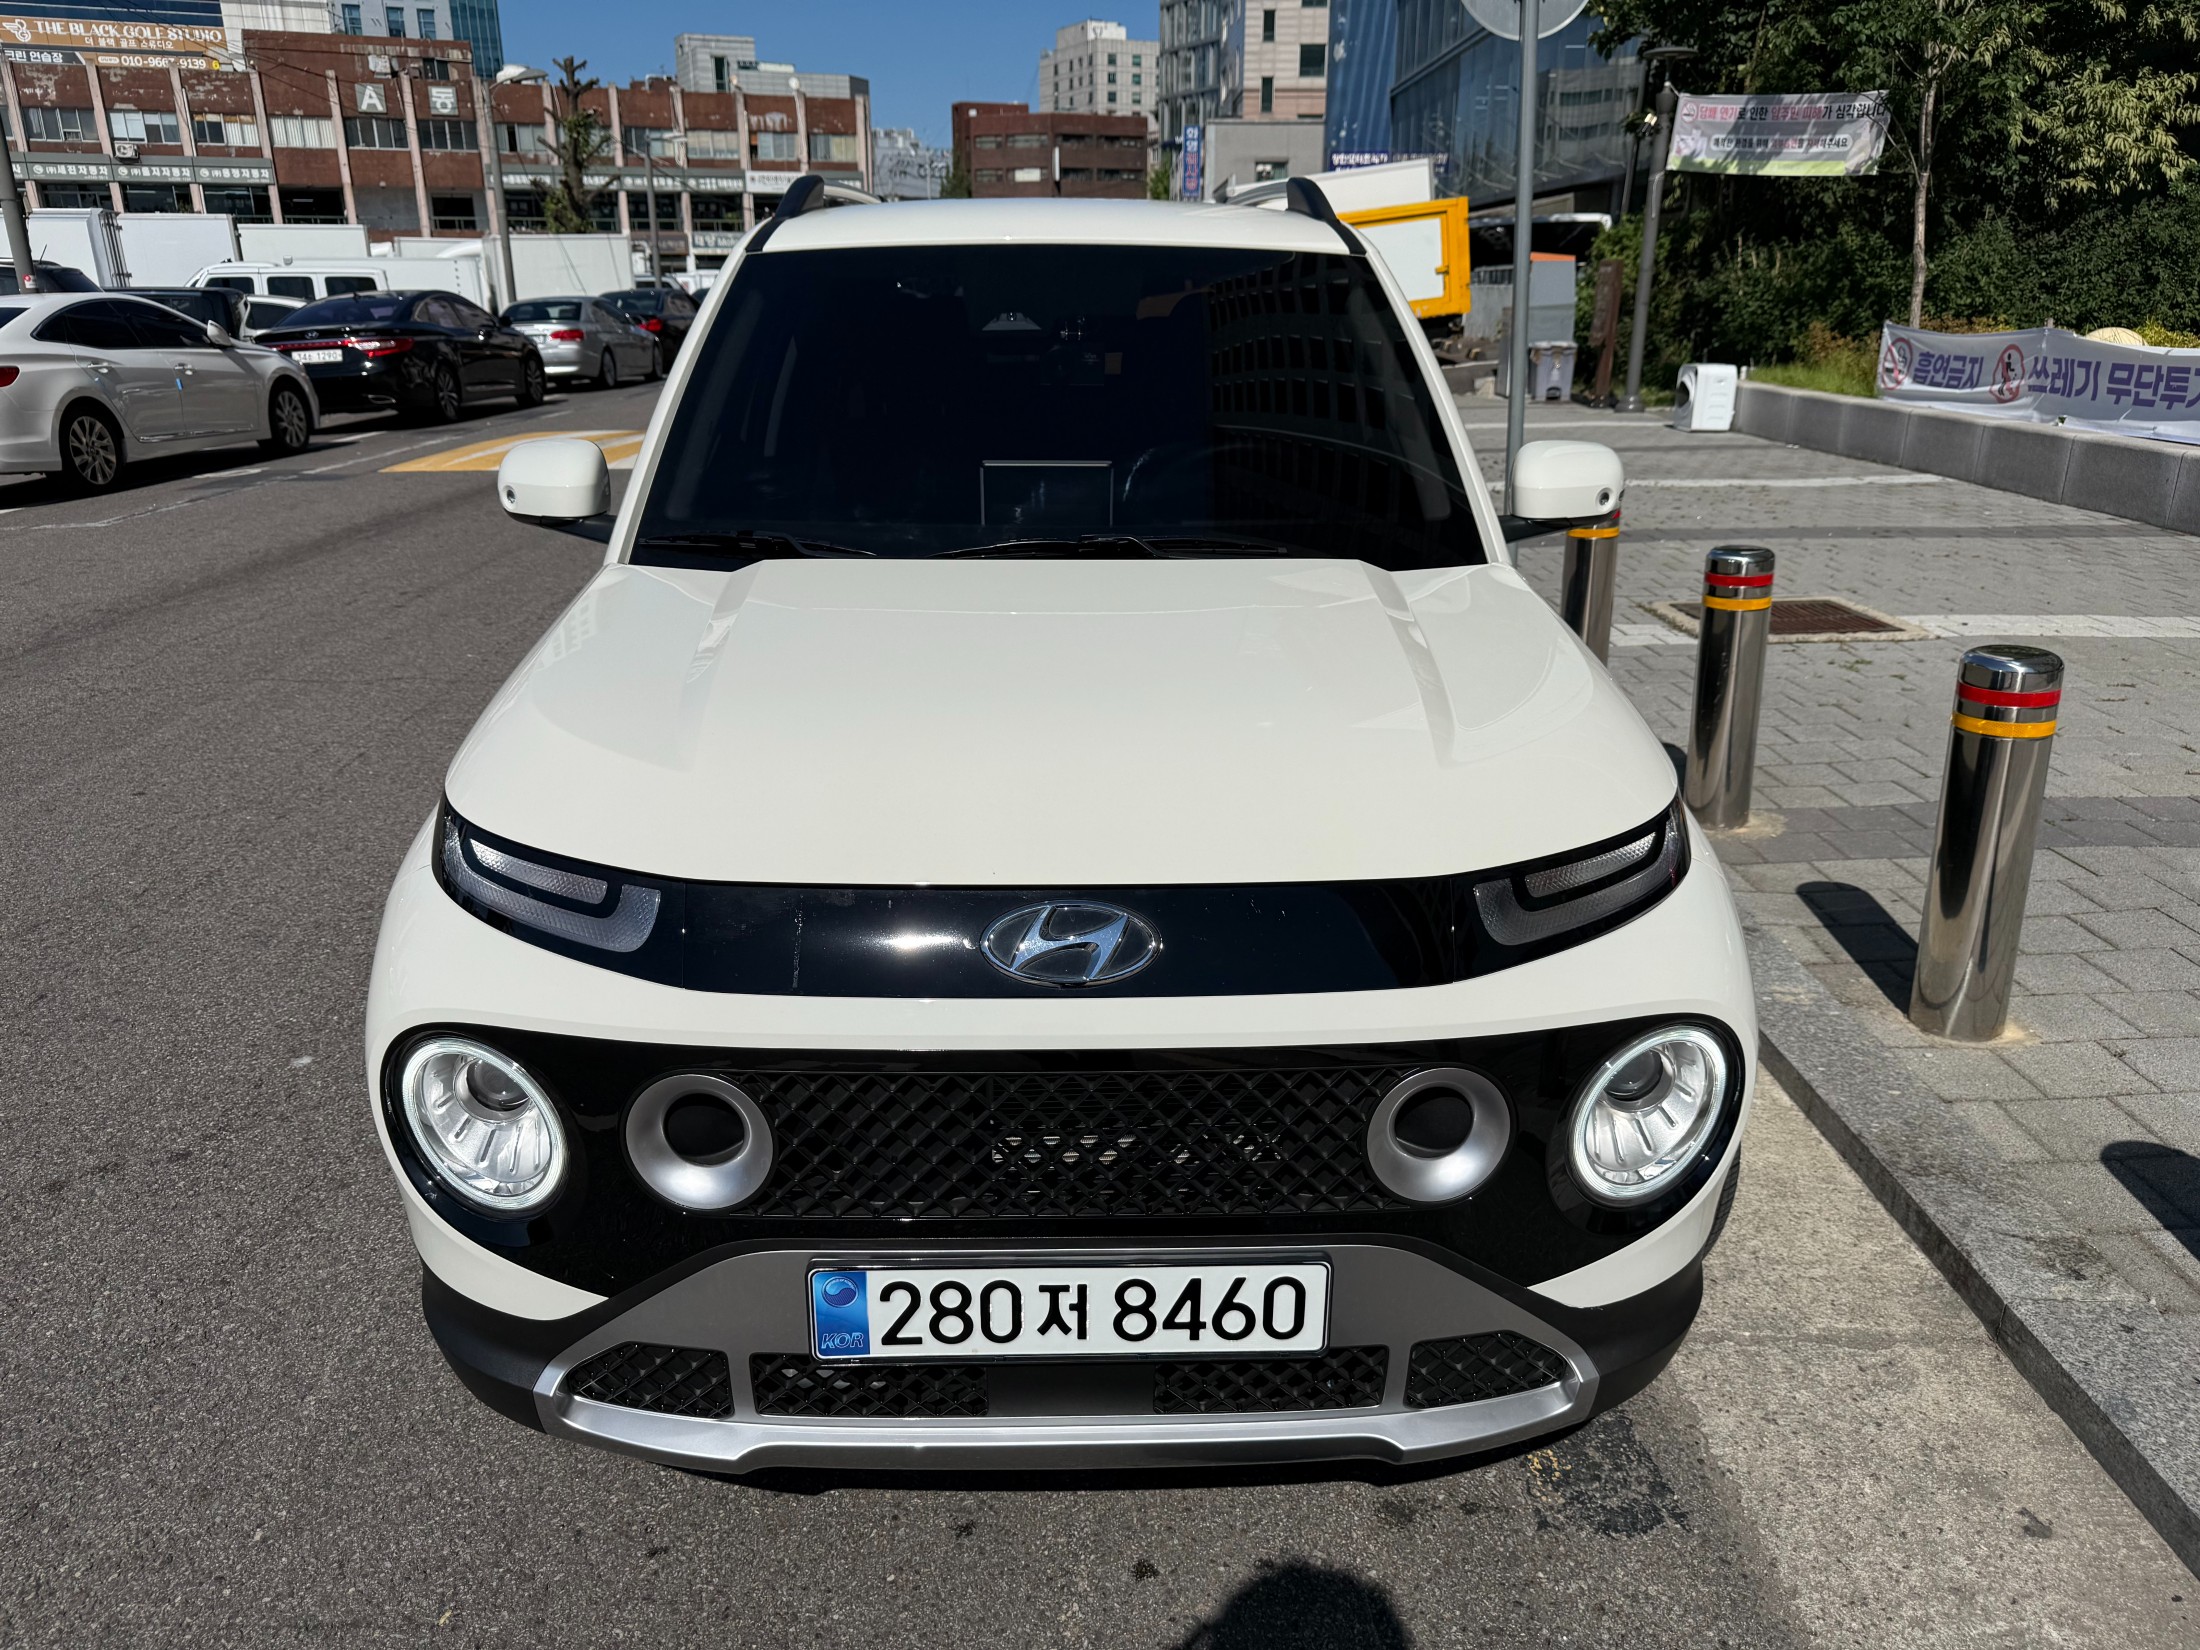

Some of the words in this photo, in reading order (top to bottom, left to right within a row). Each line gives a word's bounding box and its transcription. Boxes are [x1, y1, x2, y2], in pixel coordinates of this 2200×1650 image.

[34, 20, 67, 35] THE
[68, 22, 120, 37] BLACK
[123, 25, 164, 39] GOLF
[167, 27, 222, 43] STUDIO
[29, 50, 63, 63] 연습장
[360, 85, 384, 112] A
[1750, 104, 1769, 121] 인한
[1835, 102, 1888, 120] 심각합니다
[1913, 351, 1985, 390] 흡연금지
[2027, 355, 2102, 402] 쓰레기
[879, 1278, 1090, 1346] 280저
[1112, 1276, 1307, 1342] 8460
[821, 1332, 864, 1350] KOR
